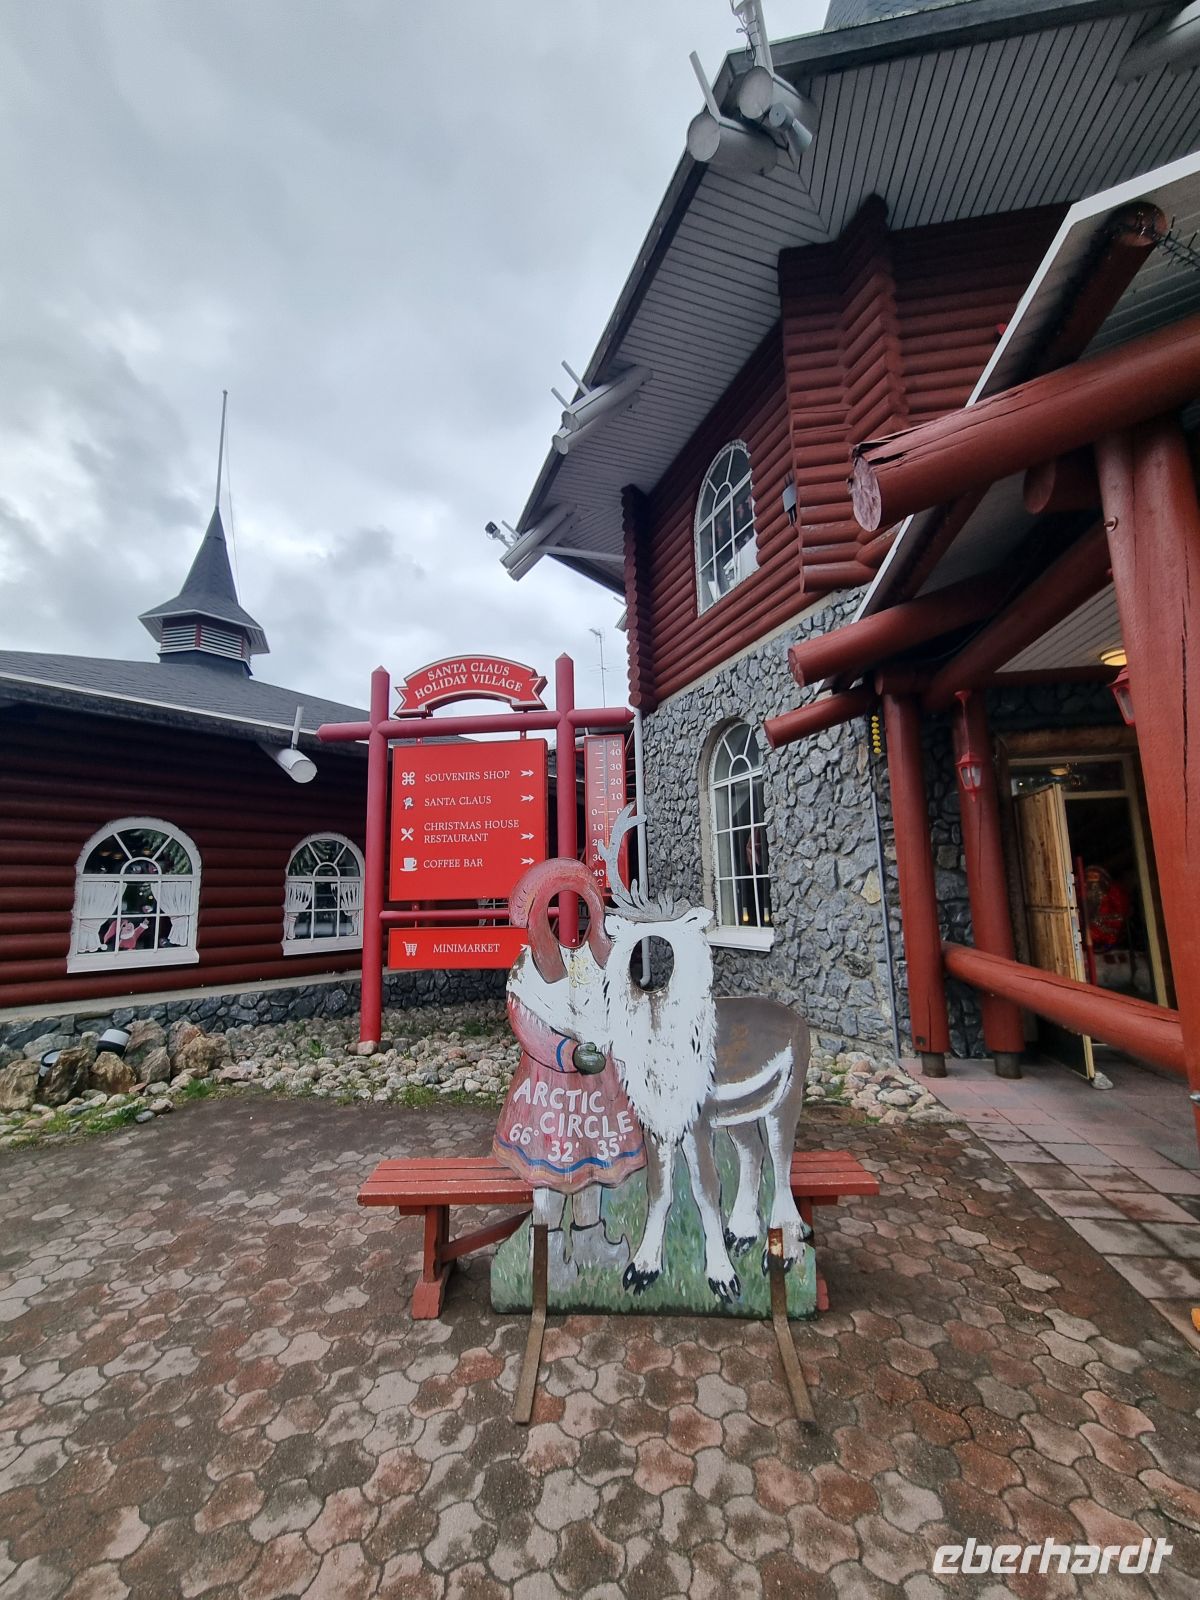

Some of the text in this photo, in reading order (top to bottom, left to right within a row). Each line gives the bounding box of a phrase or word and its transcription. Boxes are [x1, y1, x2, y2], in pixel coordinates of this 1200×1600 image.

[427, 662, 510, 681] SANTA CLAUS
[414, 674, 523, 700] HOLIDAY VILLAGE
[610, 763, 622, 771] 30
[424, 770, 511, 783] SOUVENIRS SHOP
[610, 778, 622, 786] 20
[424, 795, 492, 807] SANTA CLAUS
[611, 792, 623, 800] 10
[591, 808, 598, 816] 0
[424, 819, 520, 831] CHRISTMAS HOUSE
[593, 823, 604, 831] 10
[424, 833, 489, 844] RESTAURANT
[423, 858, 483, 869] COFFEE BAR
[593, 869, 605, 877] 40
[433, 943, 500, 953] MINIMARKET
[513, 1077, 605, 1114] ARCTIC
[540, 1111, 634, 1139] CIRCLE
[509, 1123, 540, 1145] 66°
